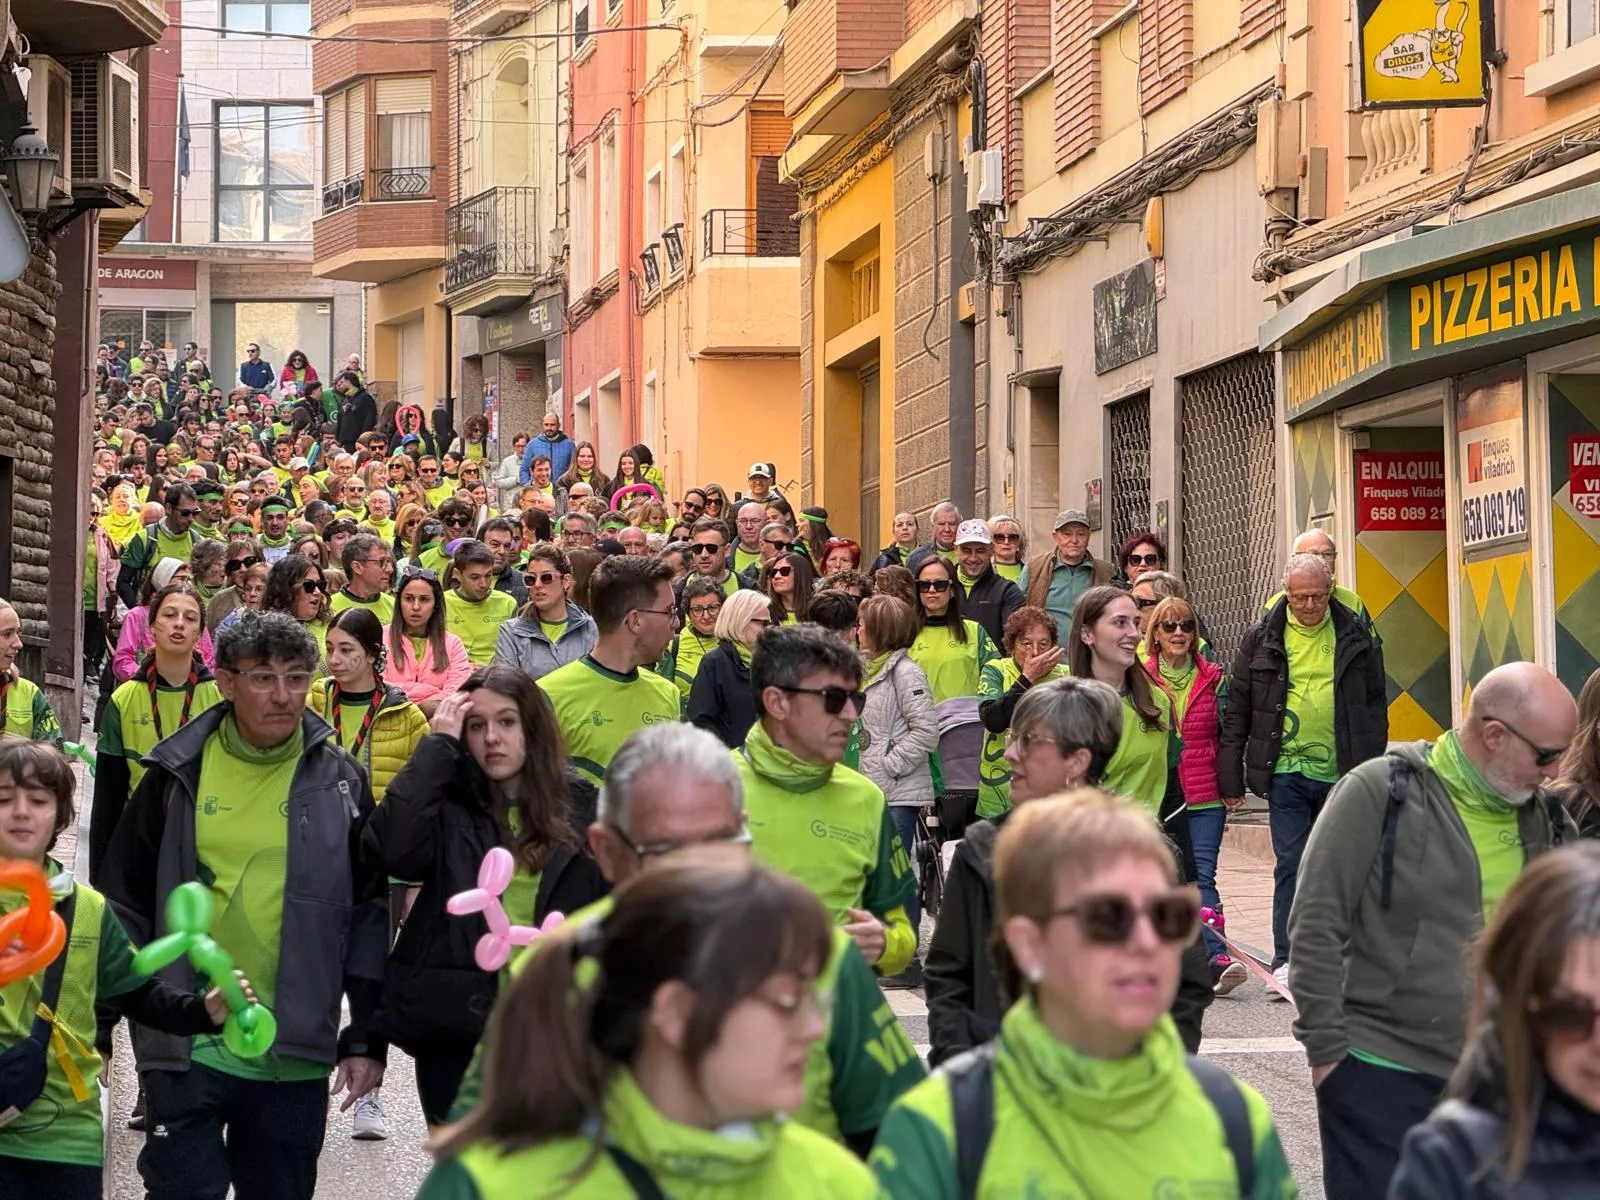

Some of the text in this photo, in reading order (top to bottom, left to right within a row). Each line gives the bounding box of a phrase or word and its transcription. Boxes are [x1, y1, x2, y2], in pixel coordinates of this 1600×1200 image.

[1392, 43, 1415, 55] BAR
[1387, 53, 1421, 68] DINO'S
[98, 268, 164, 280] DE ARAGON
[1410, 244, 1582, 351] PIZZERIA
[1286, 300, 1384, 411] HAMBURGER BAR
[1482, 437, 1510, 460] finques
[1360, 460, 1444, 481] EN ALQUIL
[1483, 455, 1516, 480] viladrich
[1363, 486, 1409, 500] Finques
[1370, 507, 1397, 520] 658
[1400, 506, 1427, 520] 089
[1463, 486, 1527, 543] 658 089 219
